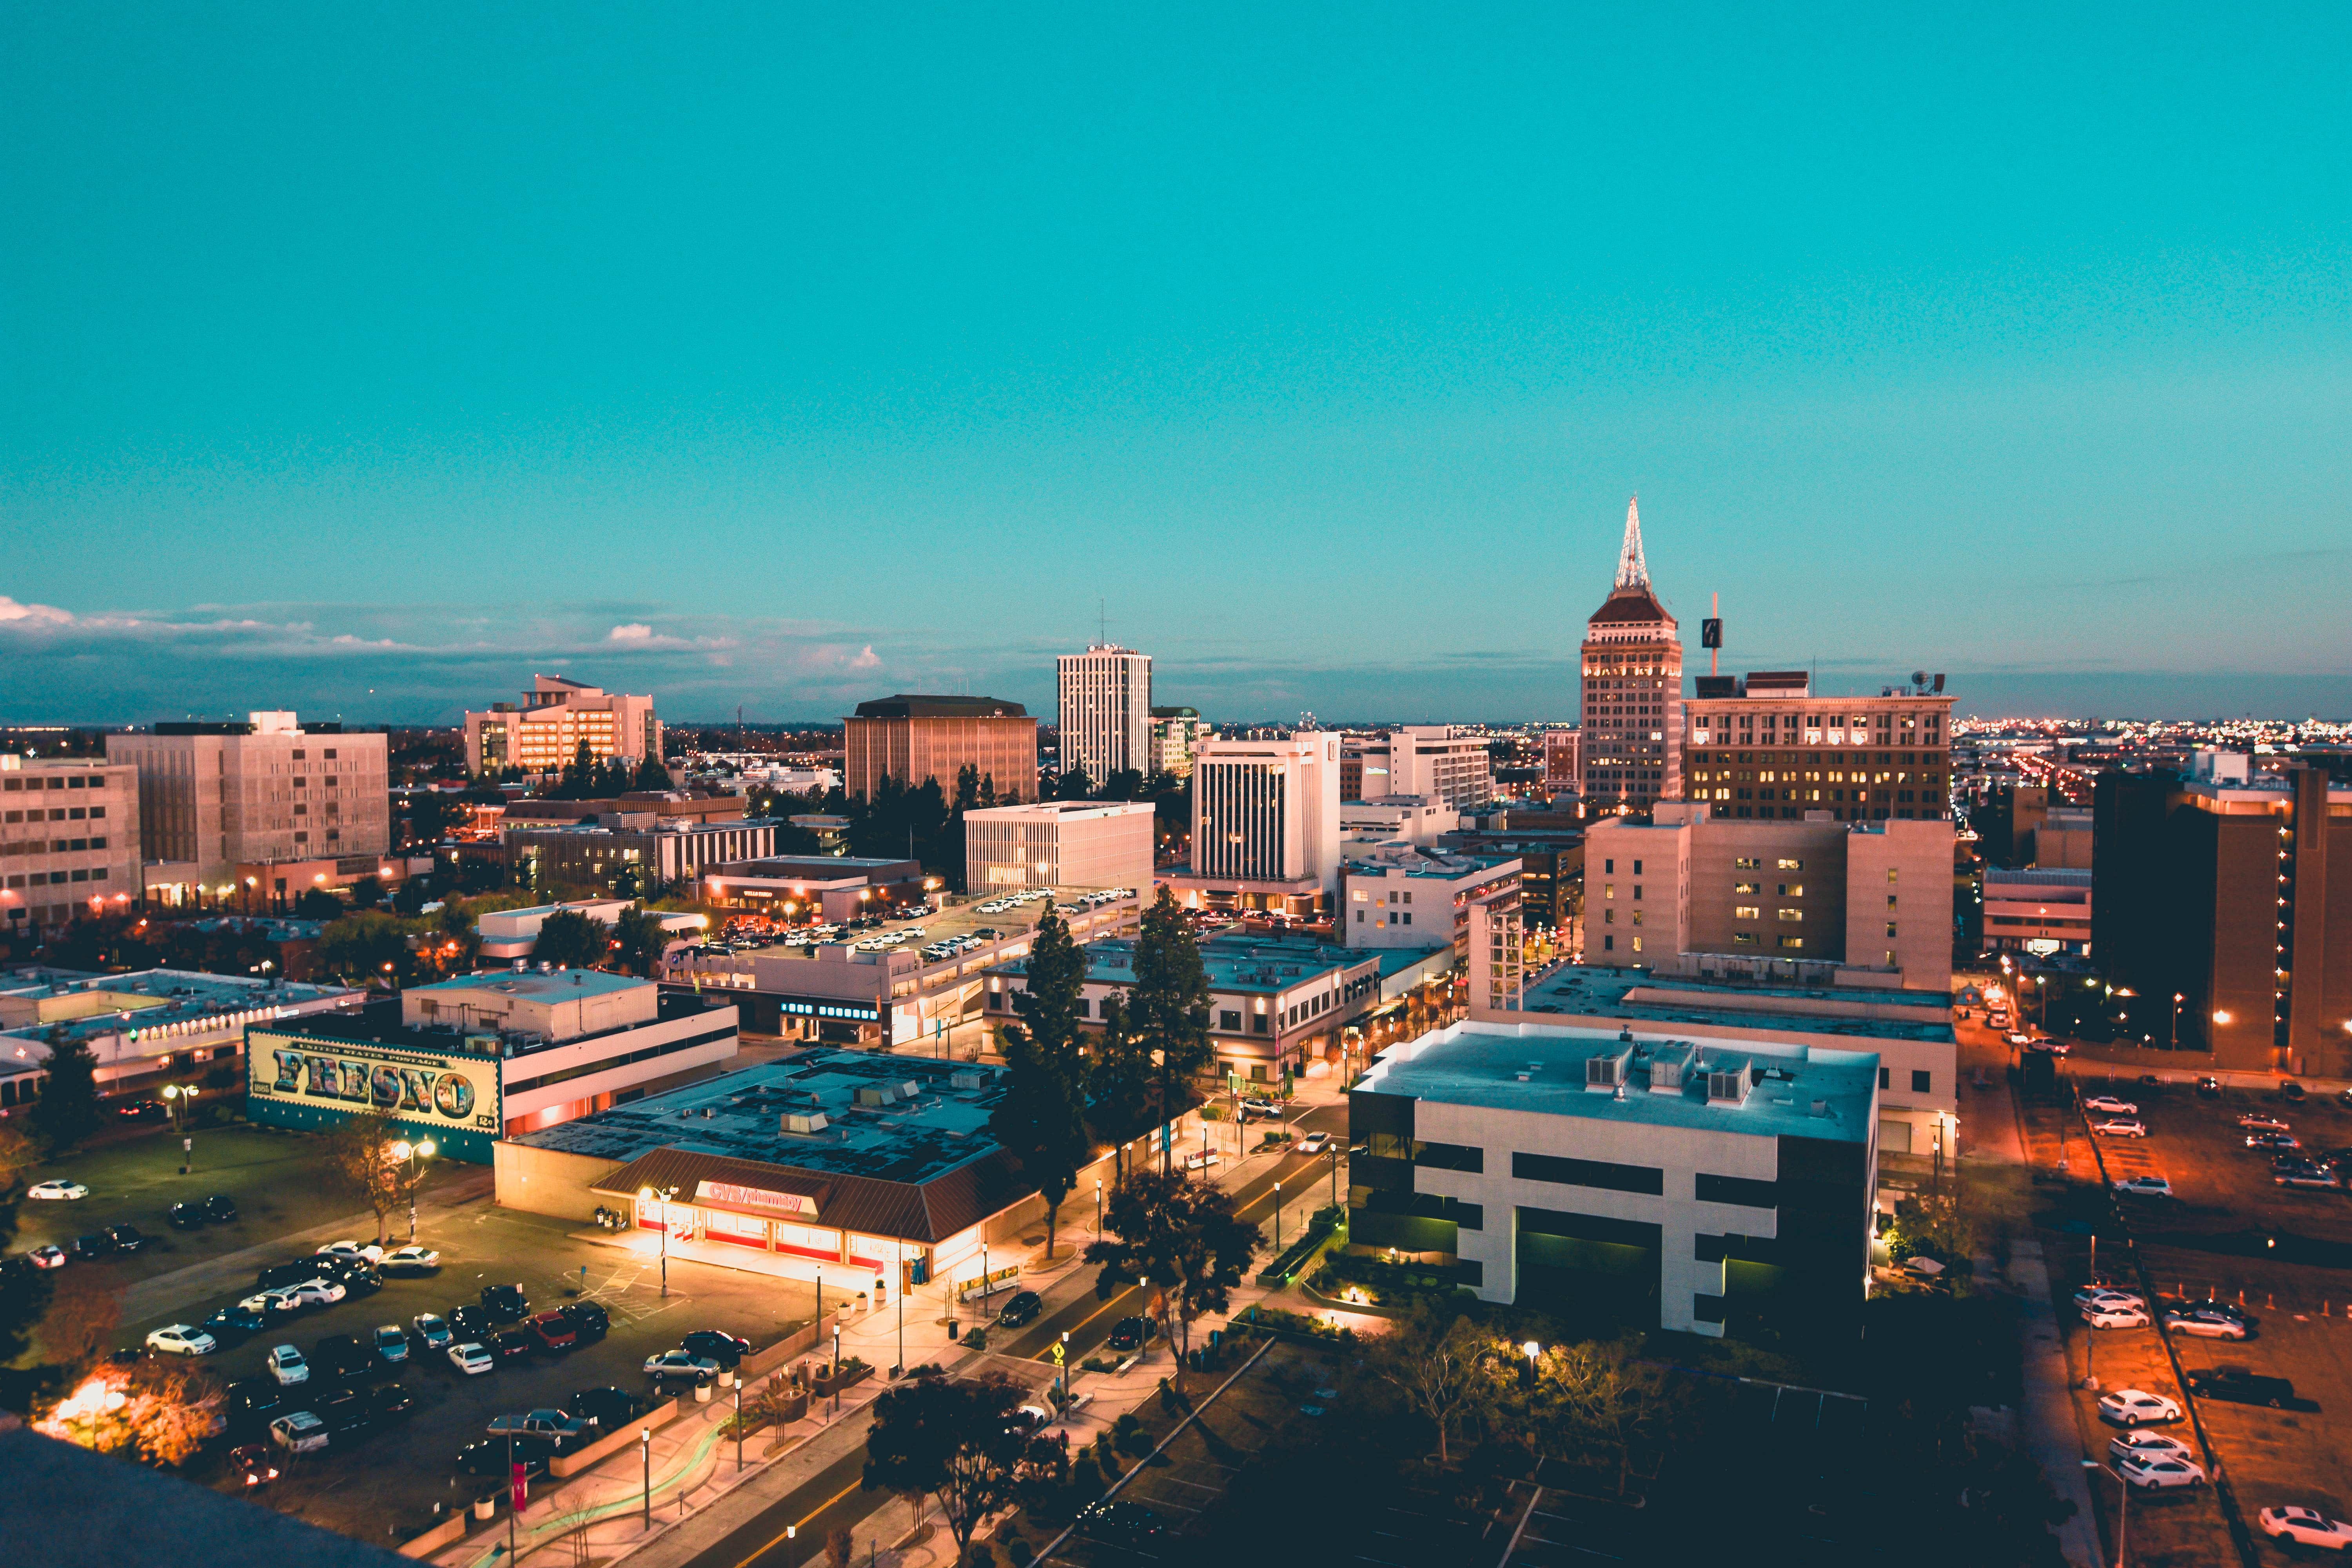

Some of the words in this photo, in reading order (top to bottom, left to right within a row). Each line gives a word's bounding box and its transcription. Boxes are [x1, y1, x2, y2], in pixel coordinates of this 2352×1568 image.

[299, 1044, 339, 1053] UNITED
[343, 1049, 384, 1059] STATES
[388, 1054, 439, 1066] POSTAGE
[273, 1049, 475, 1119] FRESNO
[709, 1183, 802, 1212] CVS/pharmacy
